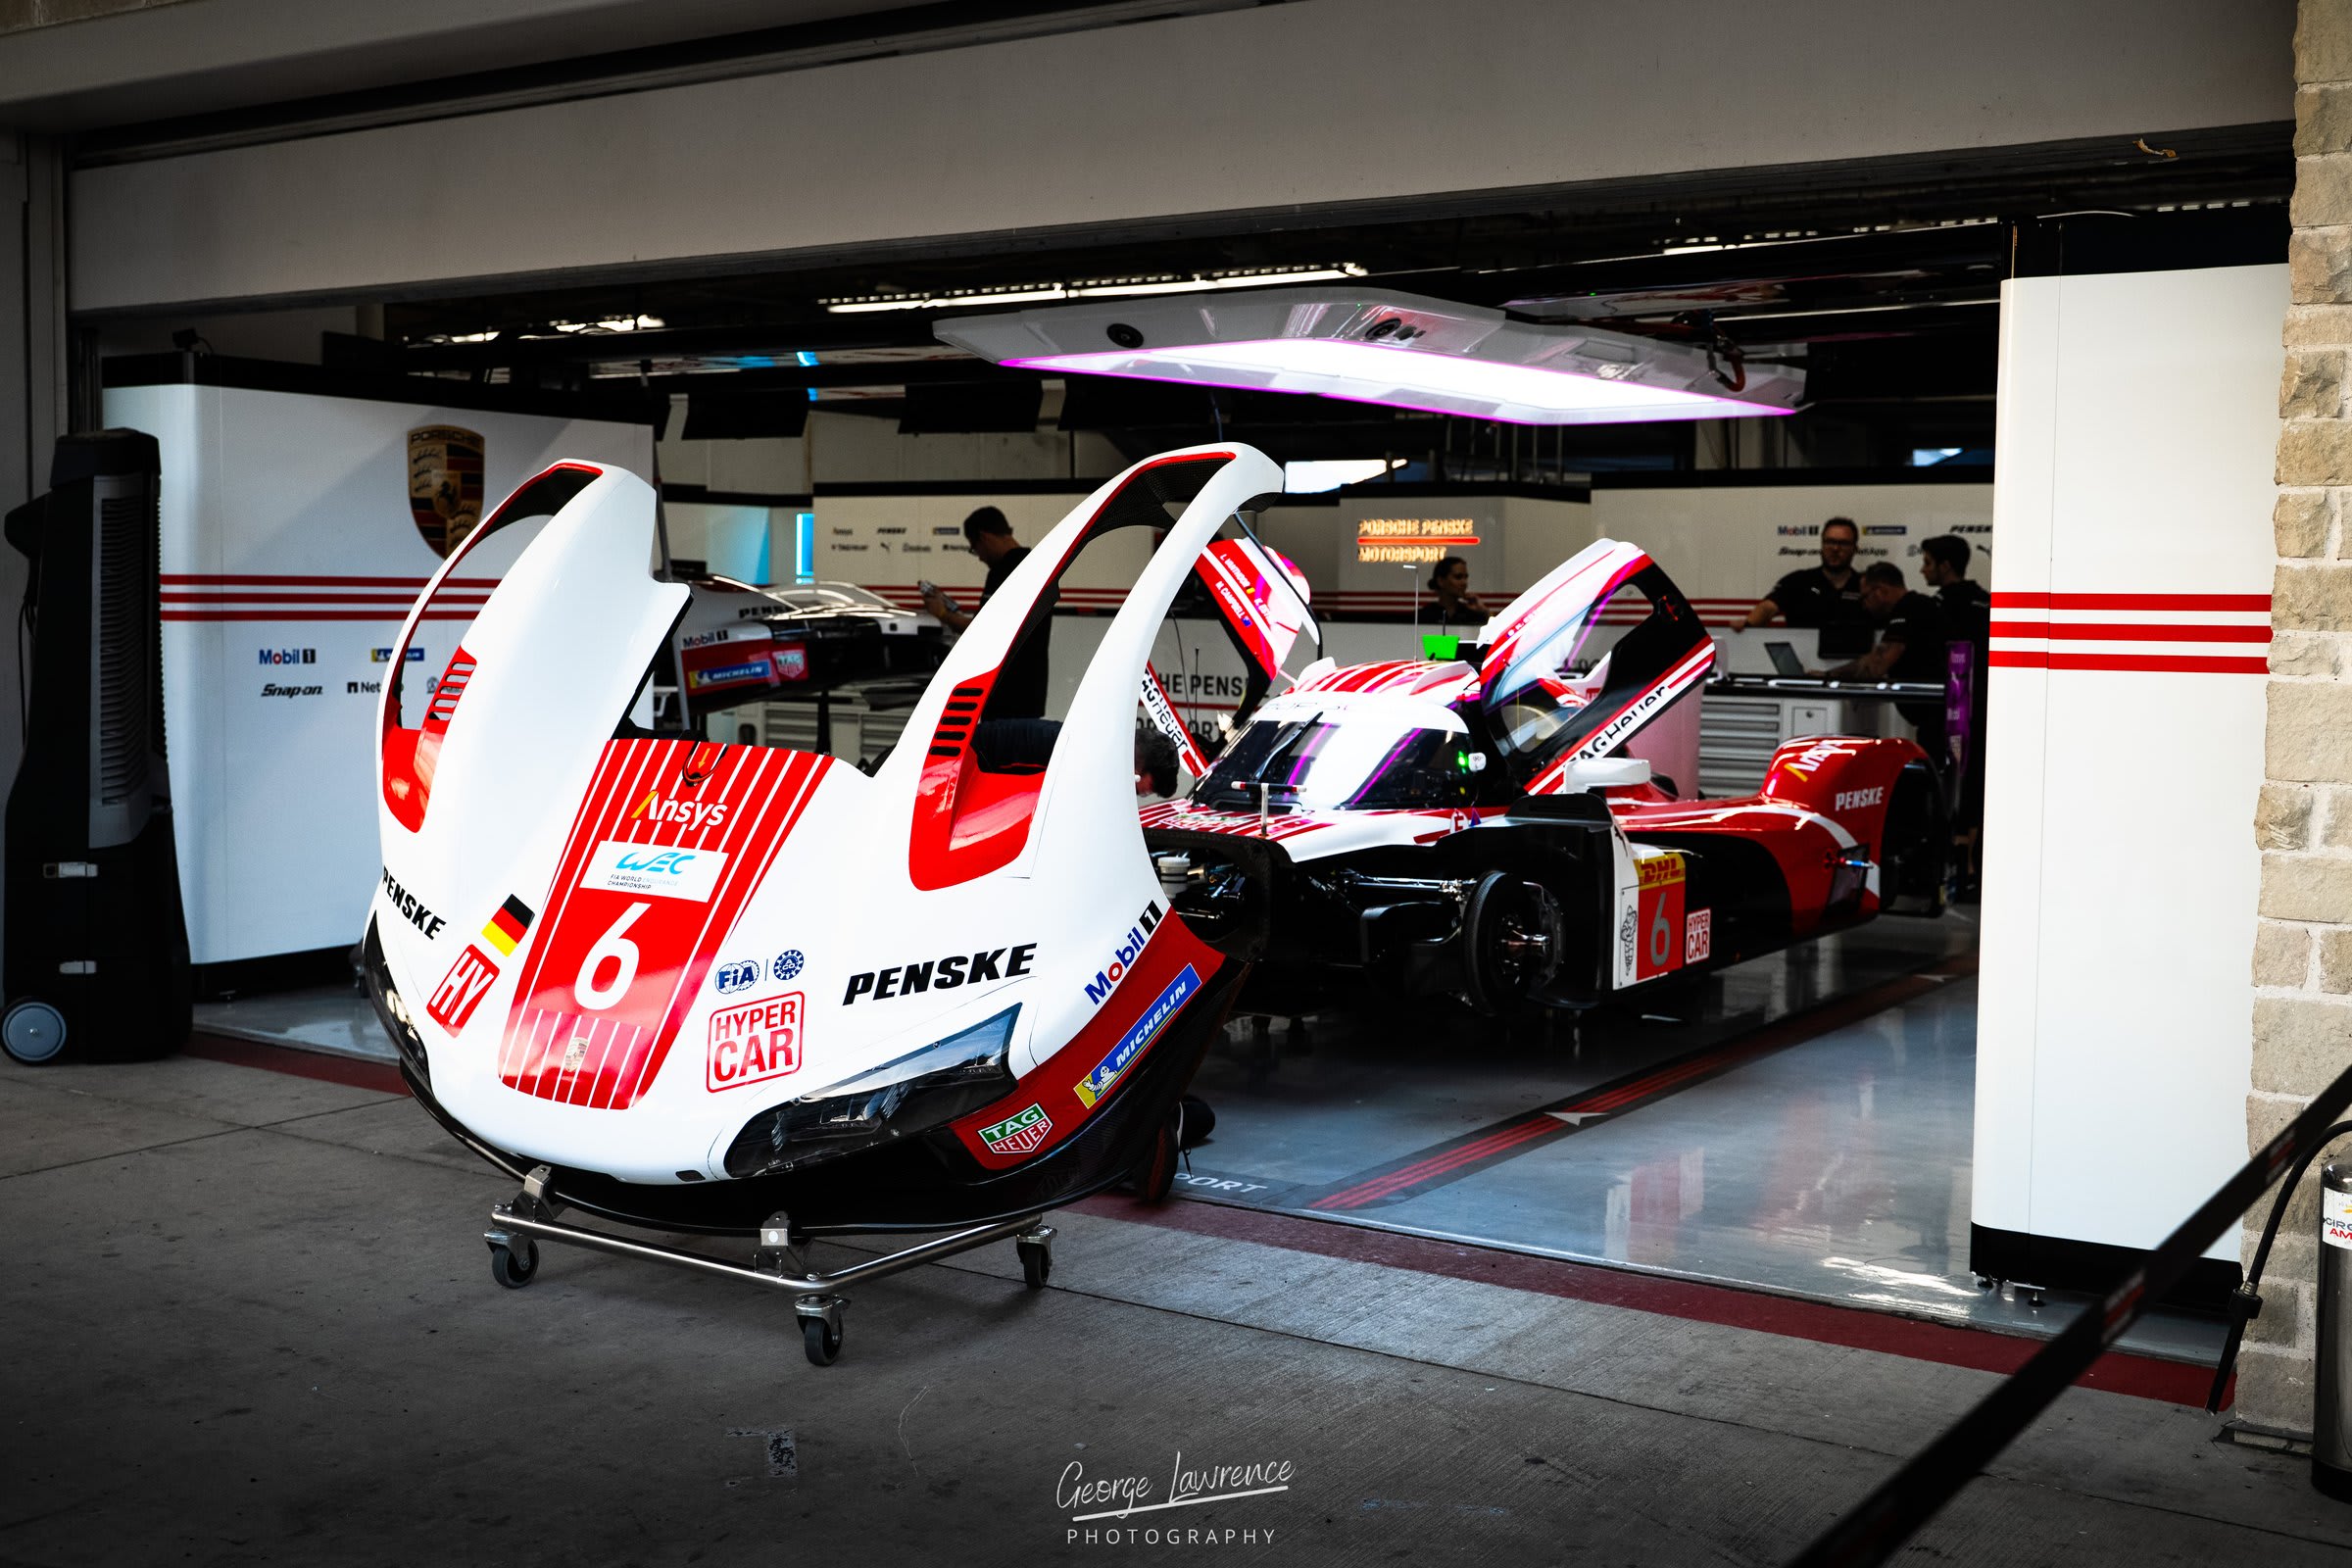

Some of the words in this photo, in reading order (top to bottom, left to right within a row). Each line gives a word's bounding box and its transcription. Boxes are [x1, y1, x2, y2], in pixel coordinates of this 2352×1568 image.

[1358, 519, 1419, 535] PORSCHE
[1421, 519, 1473, 535] PENSKE
[1950, 525, 1993, 534] PENSK
[1358, 546, 1446, 563] MOTORSPORT
[683, 631, 715, 647] Mobil
[259, 649, 300, 664] Mobil
[303, 649, 315, 663] 1
[711, 666, 762, 680] MICHELIN
[261, 683, 323, 699] Snap-on
[630, 789, 728, 831] Ansys
[1835, 786, 1884, 811] PENSKE
[615, 851, 697, 875] WEC
[1640, 858, 1681, 882] DHL
[607, 879, 652, 890] CHAMPIONSHIP
[620, 874, 642, 883] WORLD
[382, 864, 447, 941] PENSKE
[1650, 892, 1671, 967] 6
[1688, 912, 1710, 933] HYPER
[573, 902, 652, 1010] 6
[1688, 930, 1710, 959] CAR
[842, 943, 1038, 1006] PENSKE
[1084, 926, 1146, 1005] Mobil
[430, 951, 495, 1026] HY
[714, 1001, 796, 1042] HYPER
[1115, 981, 1187, 1067] MICHELIN
[713, 1027, 794, 1082] CAR
[985, 1109, 1040, 1139] TAG
[993, 1120, 1048, 1151] HEUER
